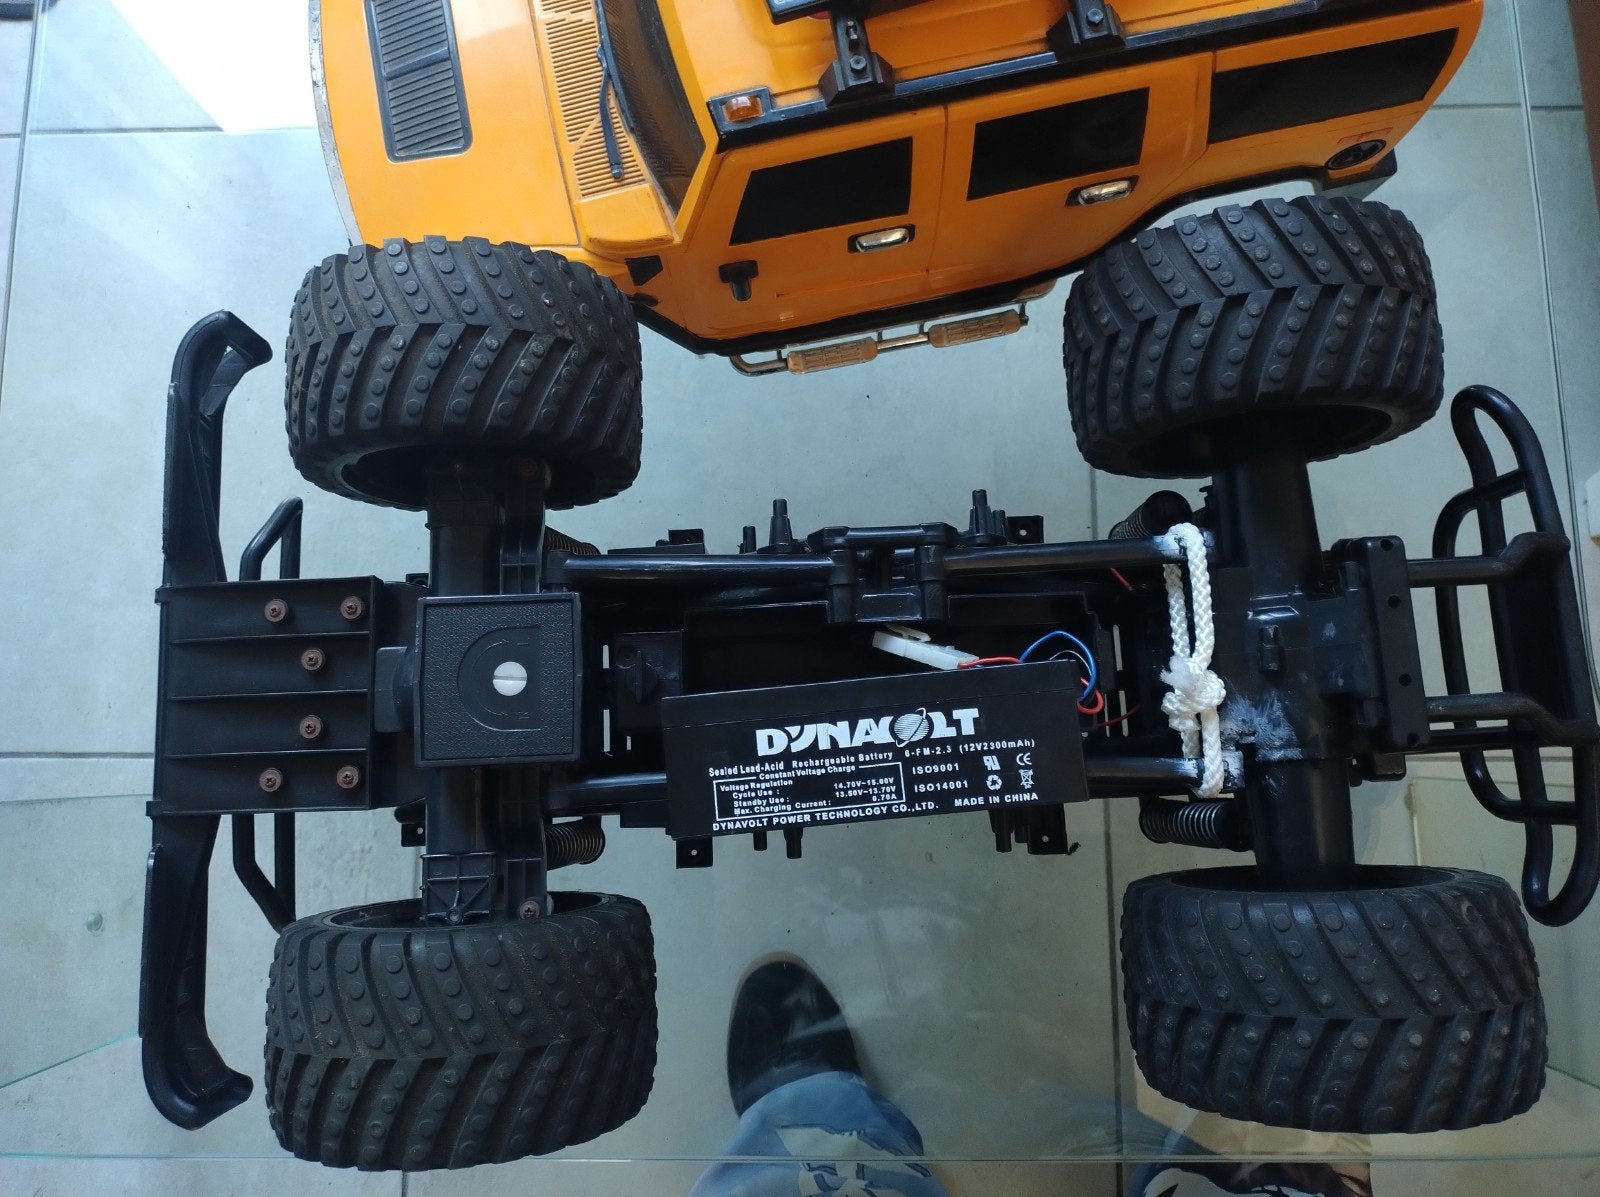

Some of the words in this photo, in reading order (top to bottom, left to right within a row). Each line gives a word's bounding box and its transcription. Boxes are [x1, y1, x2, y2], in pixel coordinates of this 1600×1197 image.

[959, 738, 1036, 754] (12V2300mAh)
[708, 766, 738, 778] Sealed
[740, 761, 784, 774] Lead-Acid
[792, 755, 855, 769] Rechargeable
[858, 752, 893, 762] Battery
[912, 762, 960, 775] ISO9001
[759, 771, 796, 780] Constant
[796, 766, 826, 776] Voltage
[827, 764, 856, 774] Charge
[720, 783, 749, 792] Voltage
[750, 779, 794, 790] Regulation
[914, 780, 969, 793] ISO14001
[732, 791, 756, 800] Cycle
[757, 789, 773, 797] Use
[954, 797, 985, 807] MADE
[988, 795, 1000, 804] IN
[1004, 792, 1039, 803] CHINA
[733, 798, 767, 808] Standby
[754, 804, 792, 815] Charging
[712, 818, 769, 831] DYNAVOLT
[772, 813, 812, 826] POWER
[814, 805, 889, 821] TECHNOLOGY
